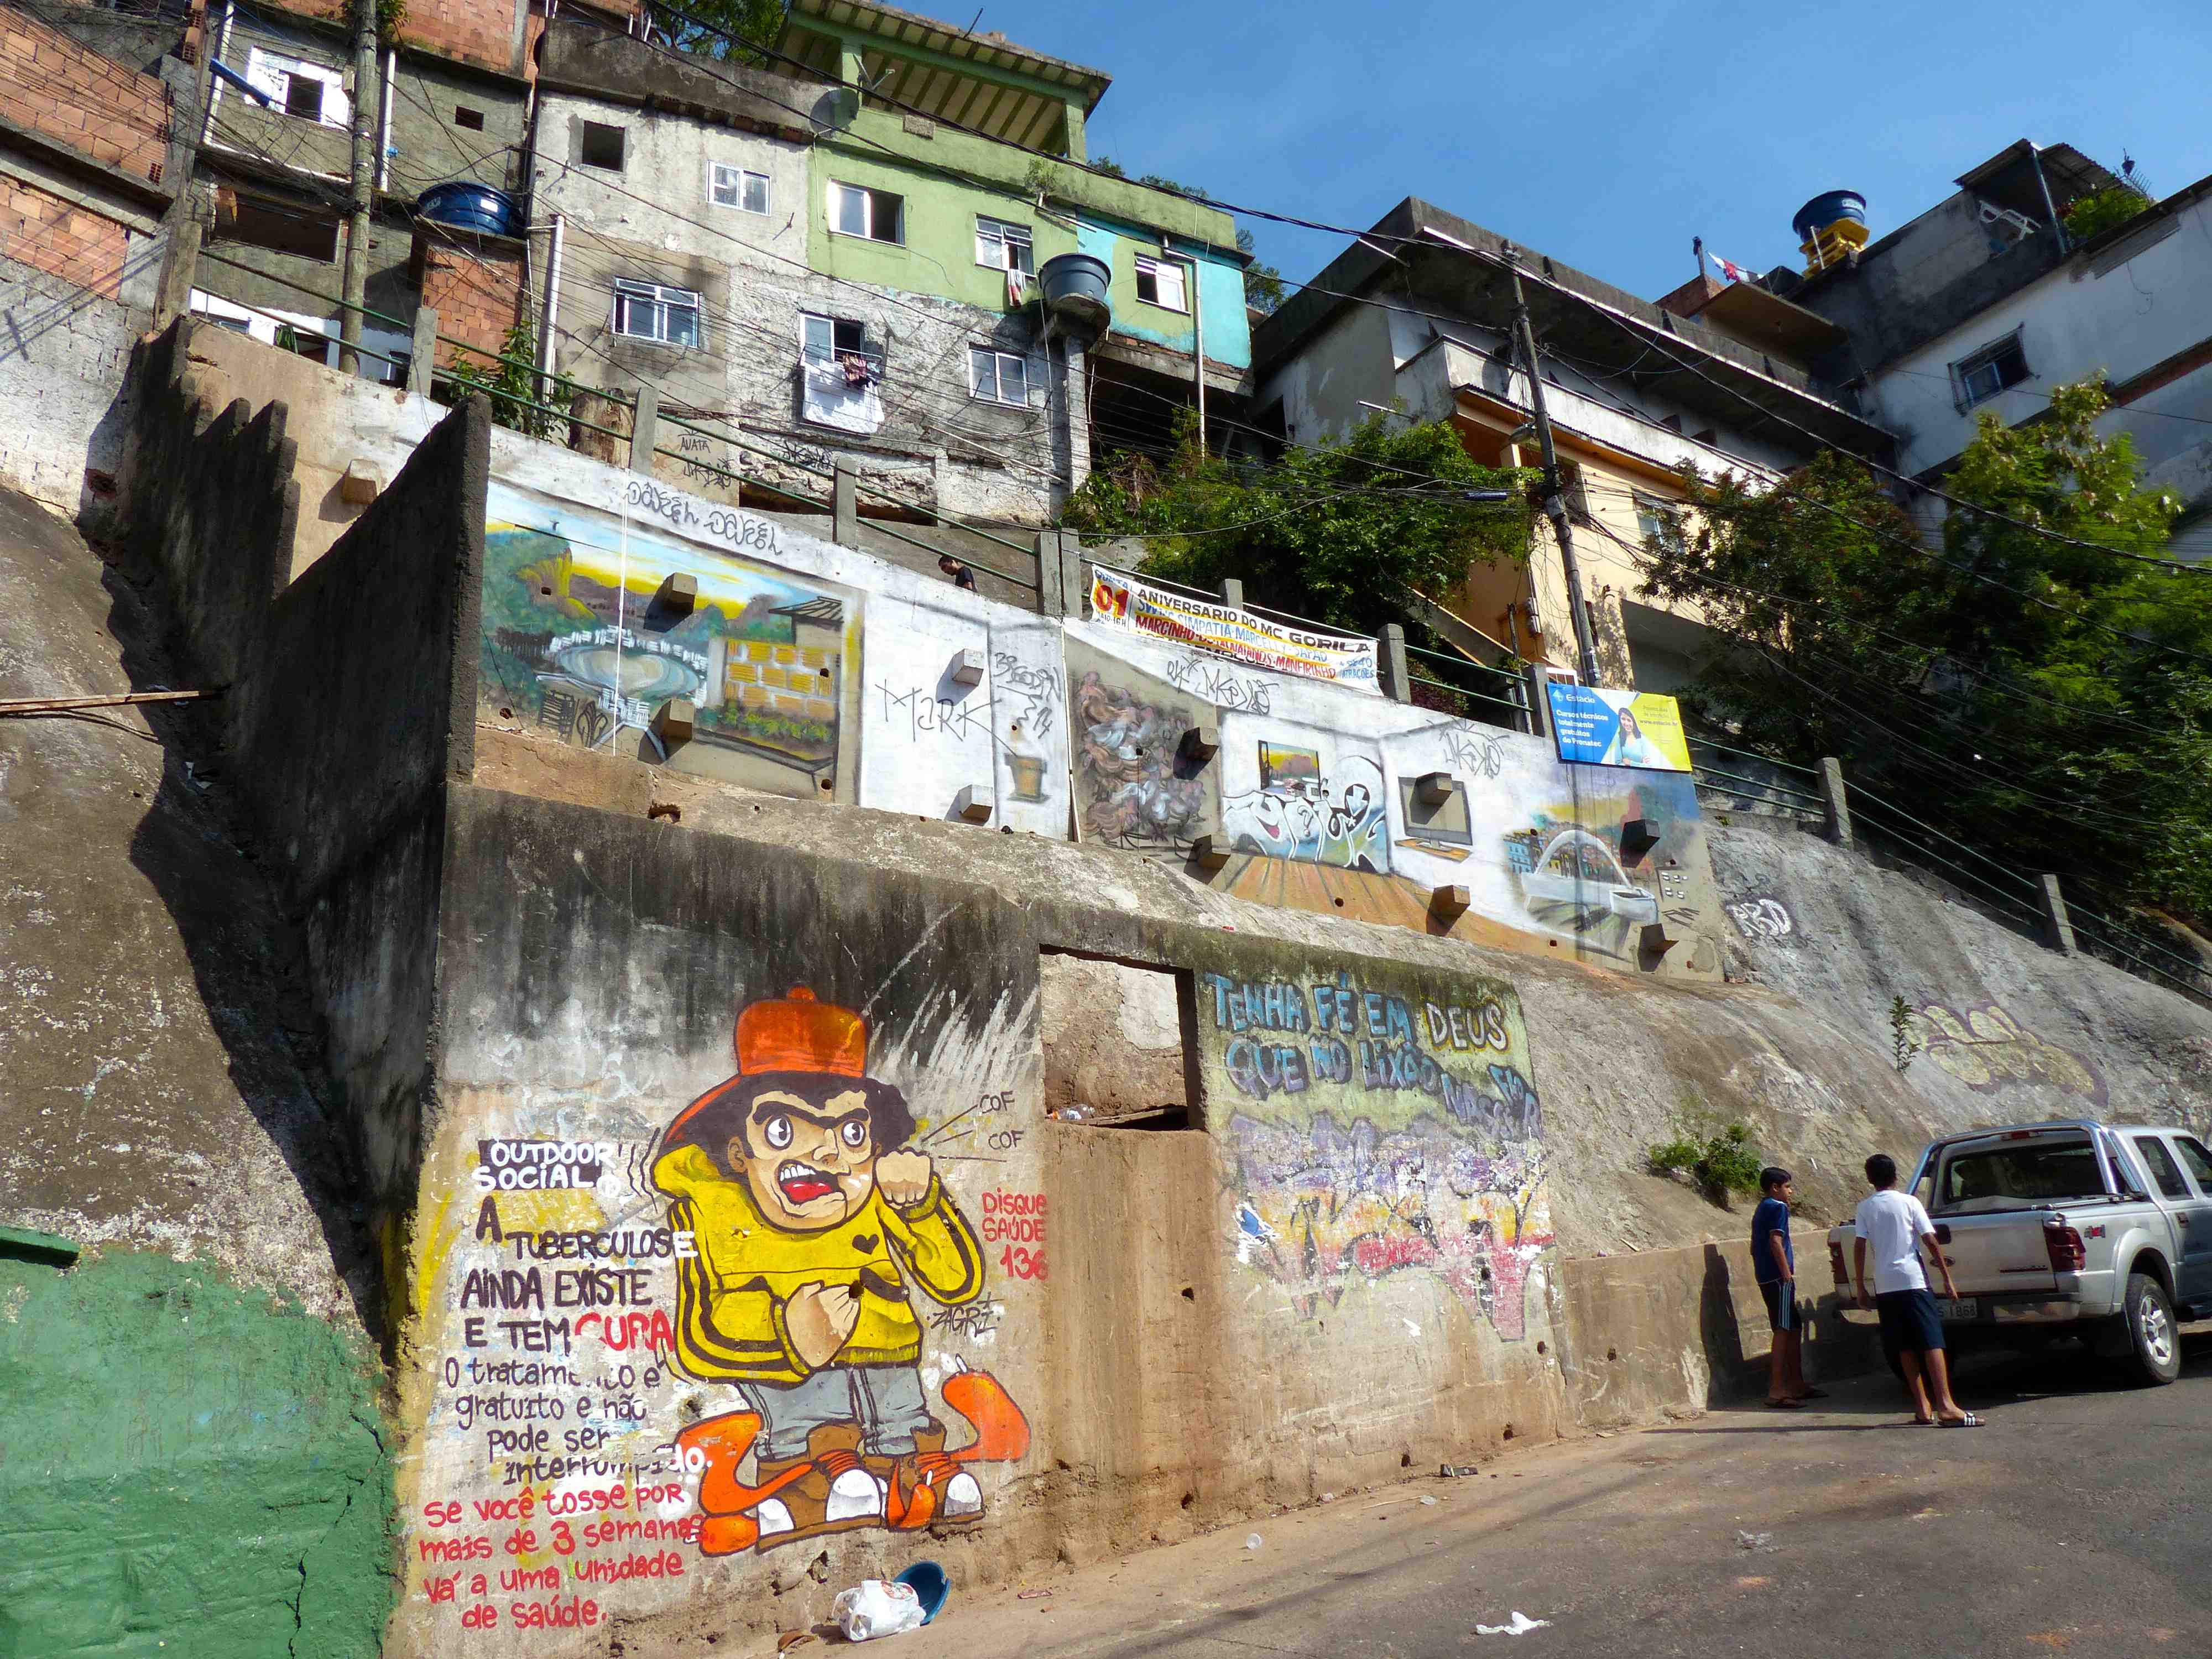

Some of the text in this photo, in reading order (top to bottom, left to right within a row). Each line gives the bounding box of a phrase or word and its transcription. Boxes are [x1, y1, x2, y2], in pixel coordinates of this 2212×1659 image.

[1241, 614, 1257, 629] DO
[1261, 623, 1282, 639] MC
[1289, 632, 1370, 653] GORILA
[1423, 1000, 1511, 1053] DEUS
[1224, 1033, 1309, 1102] QUE
[979, 1091, 1016, 1114] COF
[491, 1139, 616, 1168] OUTDOOR
[988, 1130, 1024, 1150] COF
[476, 1194, 503, 1243] A
[504, 1229, 698, 1260] TUBERCULOSE
[465, 1317, 488, 1348] E
[497, 1316, 571, 1357] TEM
[455, 1391, 565, 1431] gratuito
[576, 1396, 593, 1419] e
[487, 1423, 612, 1463] pode ser
[473, 1486, 535, 1521] você
[542, 1483, 629, 1516] tosse
[419, 1535, 493, 1564] mais
[504, 1528, 540, 1556] de
[550, 1521, 576, 1556] 3
[470, 1573, 487, 1597] a
[500, 1566, 560, 1592] uma
[574, 1549, 685, 1584] unidade
[461, 1603, 498, 1629] de
